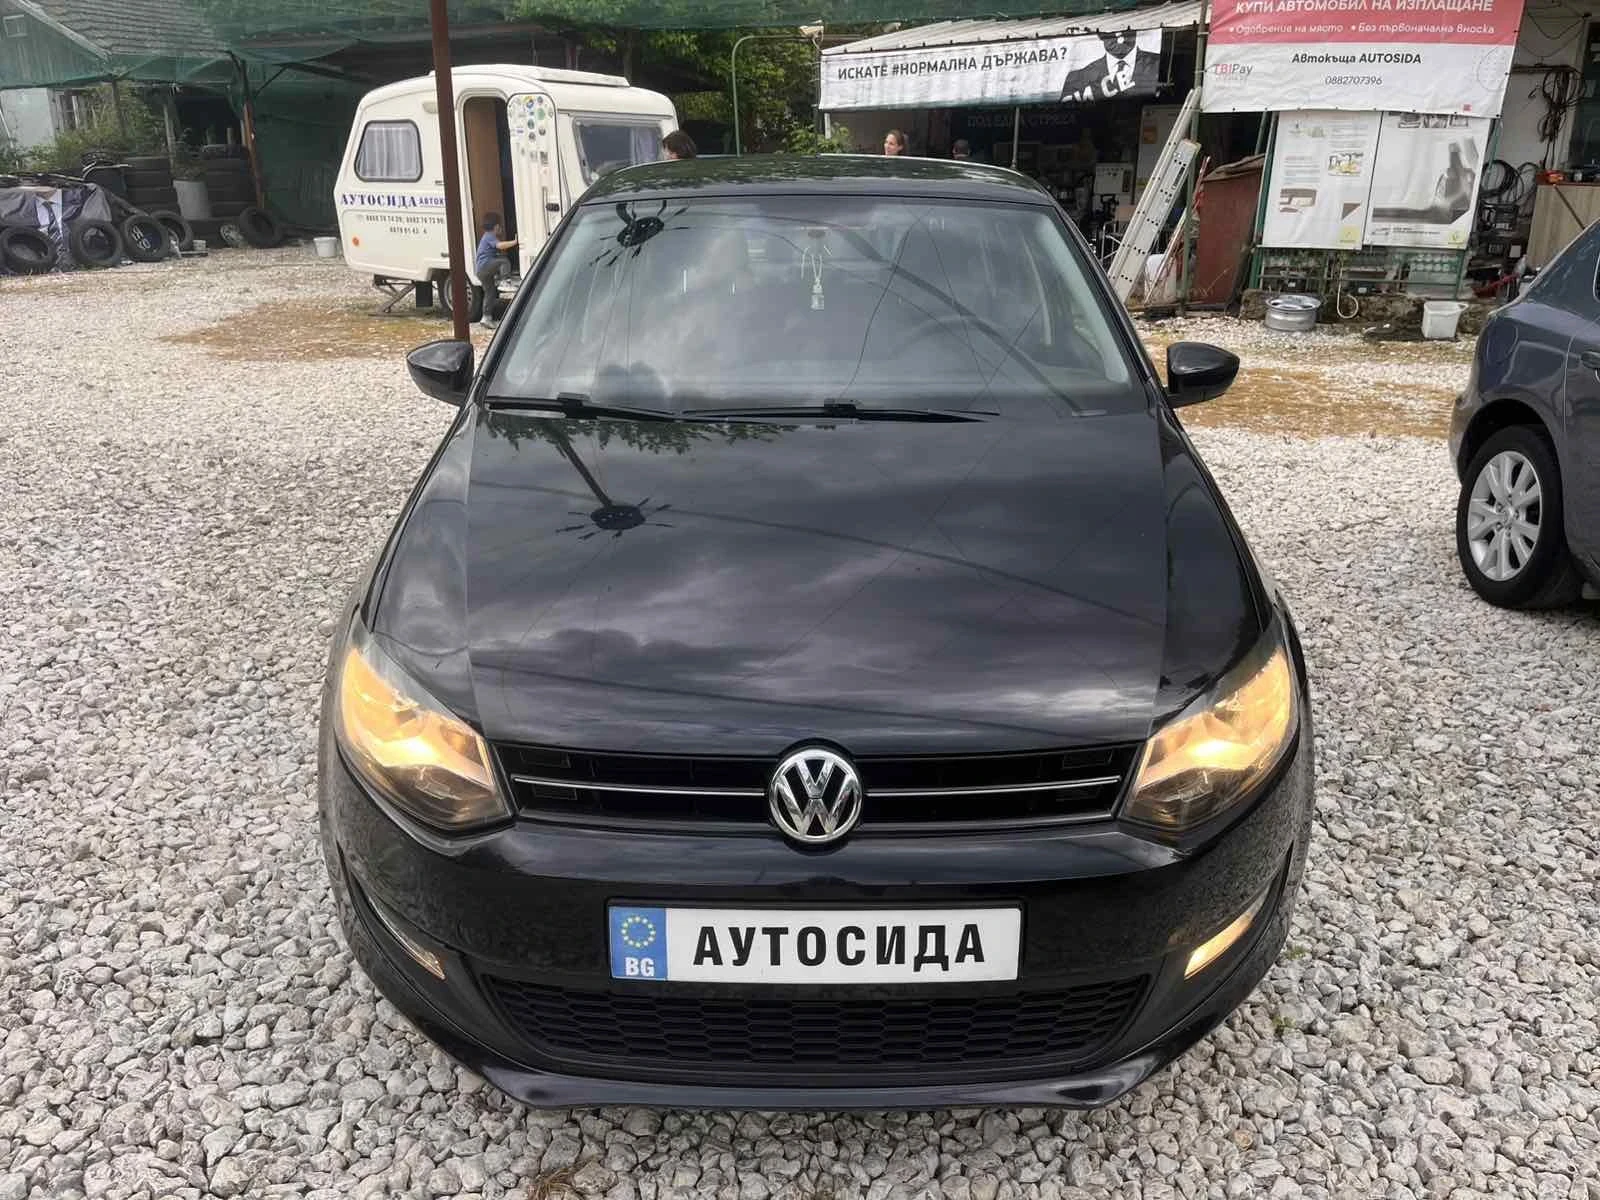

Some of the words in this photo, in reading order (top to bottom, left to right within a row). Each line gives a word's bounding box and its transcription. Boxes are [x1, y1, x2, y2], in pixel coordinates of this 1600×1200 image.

[1236, 0, 1273, 13] КУПИ
[1276, 0, 1367, 12] АВТОМОБИЛ
[1371, 0, 1393, 11] НА
[1396, 0, 1493, 12] ИЗПЛАЩАНЕ
[838, 64, 889, 80] ИСКАТЕ
[892, 56, 977, 75] #НОРМАЛНА
[981, 47, 1068, 71] ДЪРЖАВА?
[1292, 53, 1356, 64] Автокъща
[1359, 53, 1422, 64] AUTOSIDA
[1325, 75, 1383, 85] 0882707396
[341, 194, 417, 208] АУТОСИДА
[693, 923, 986, 973] АУТОСИДА
[624, 957, 656, 978] BG
